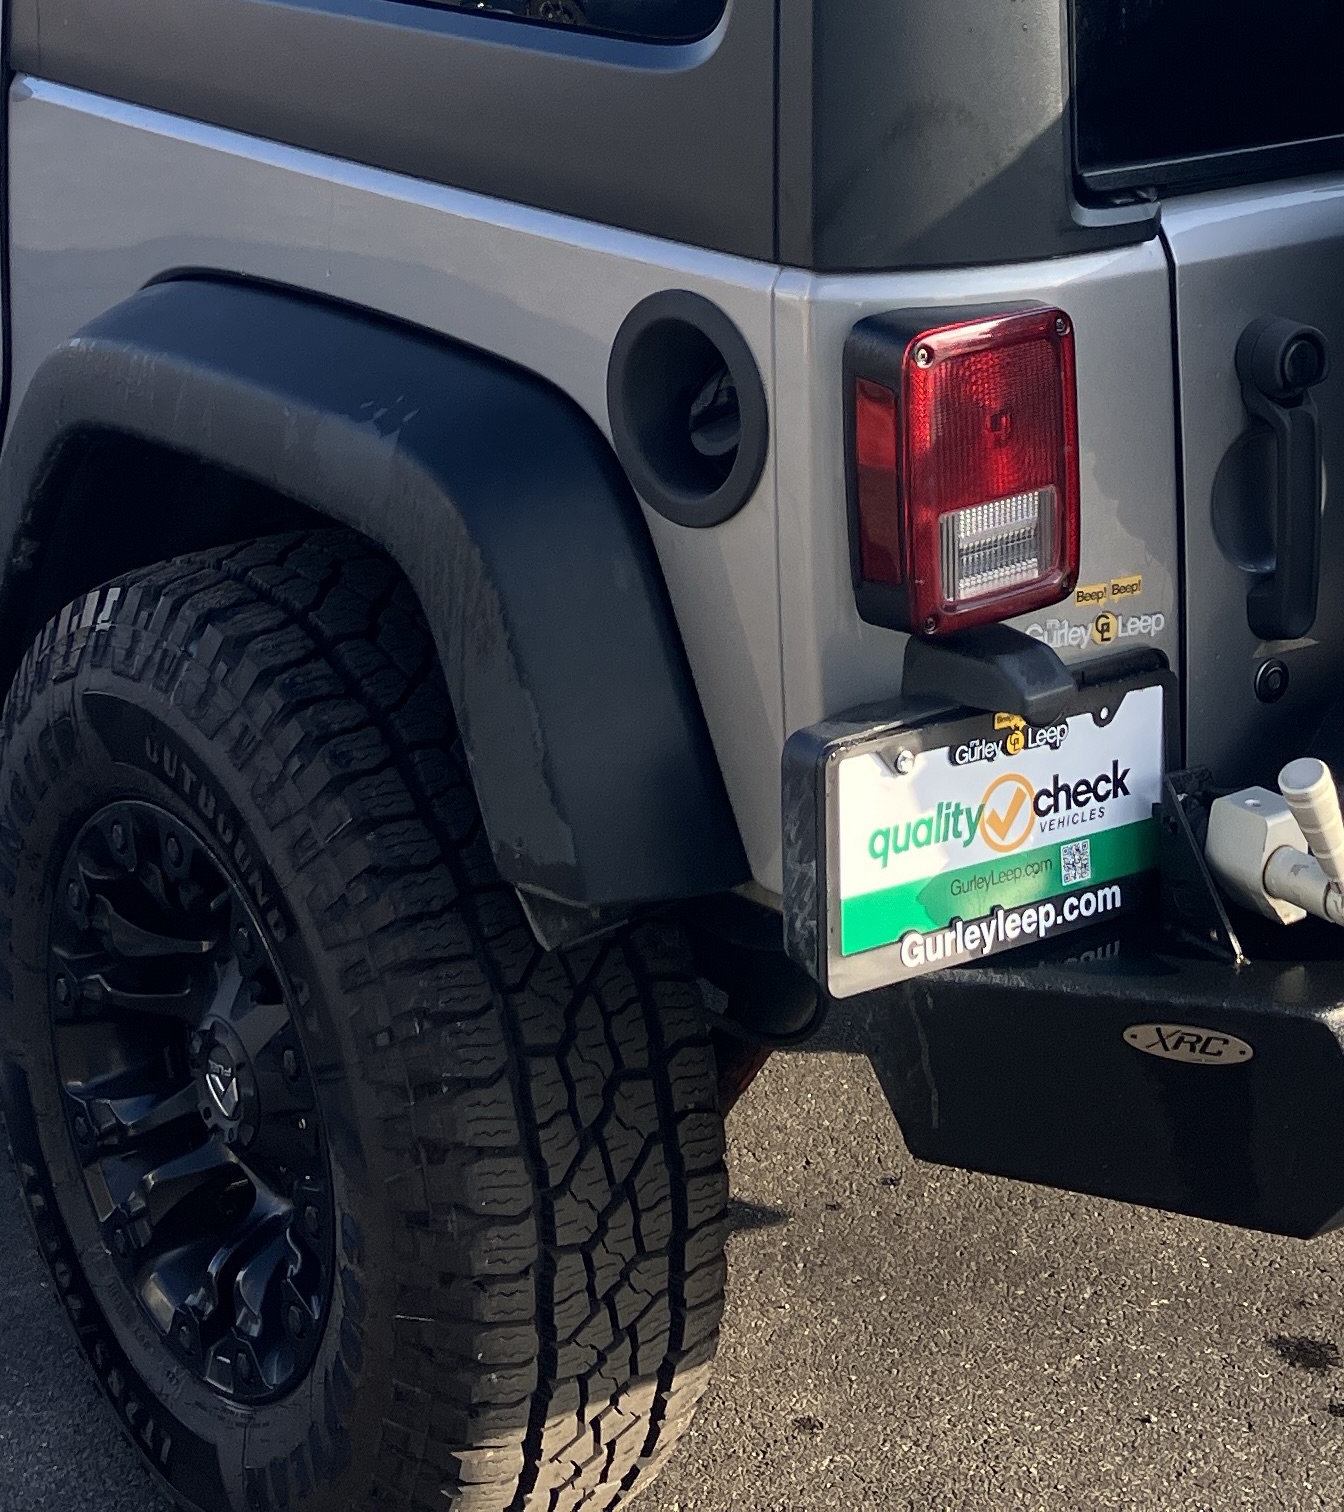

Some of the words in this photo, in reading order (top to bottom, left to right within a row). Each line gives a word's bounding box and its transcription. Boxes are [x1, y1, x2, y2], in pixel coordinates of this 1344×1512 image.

[1076, 587, 1106, 603] Beep!
[1111, 579, 1142, 595] Beep!
[1117, 613, 1164, 637] Leep
[955, 738, 1002, 765] Gurley
[1027, 724, 1068, 751] Leep
[868, 800, 986, 869] quality
[1032, 759, 1132, 819] check
[1038, 805, 1107, 834] VEHICLES
[950, 858, 1054, 898] GurleyLeep.com
[901, 884, 1123, 969] Gurleyleep.com
[1145, 1026, 1230, 1058] XRC
